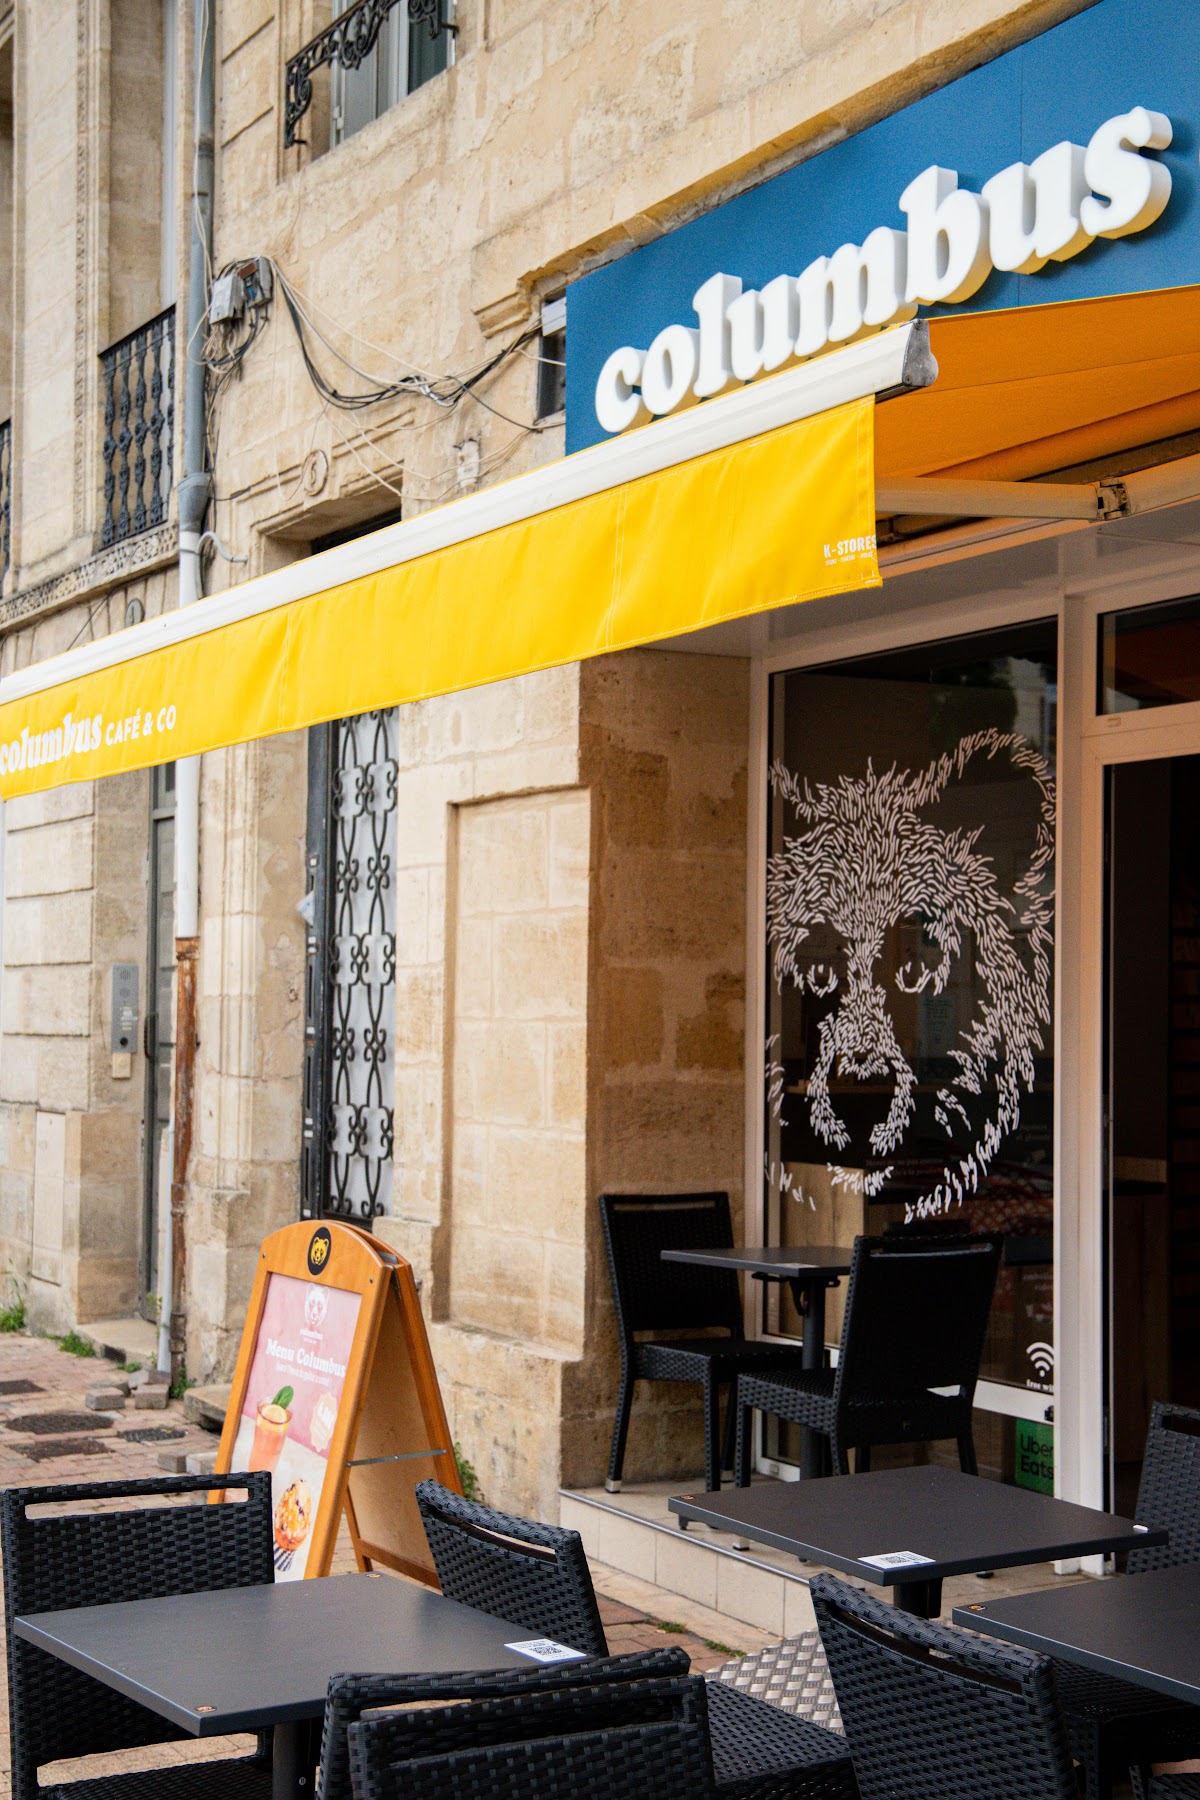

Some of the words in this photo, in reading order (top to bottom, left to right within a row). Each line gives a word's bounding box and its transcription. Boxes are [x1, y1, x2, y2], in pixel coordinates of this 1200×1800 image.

[595, 106, 1173, 433] columbus
[823, 533, 877, 559] K-STORES
[0, 712, 103, 776] columbus
[105, 708, 141, 746] CAFÉ
[143, 711, 153, 737] &
[156, 704, 177, 733] CO
[266, 1338, 295, 1362] Menu
[297, 1348, 346, 1378] Columbus
[1020, 1433, 1054, 1457] Uber
[1020, 1454, 1054, 1480] Eats
